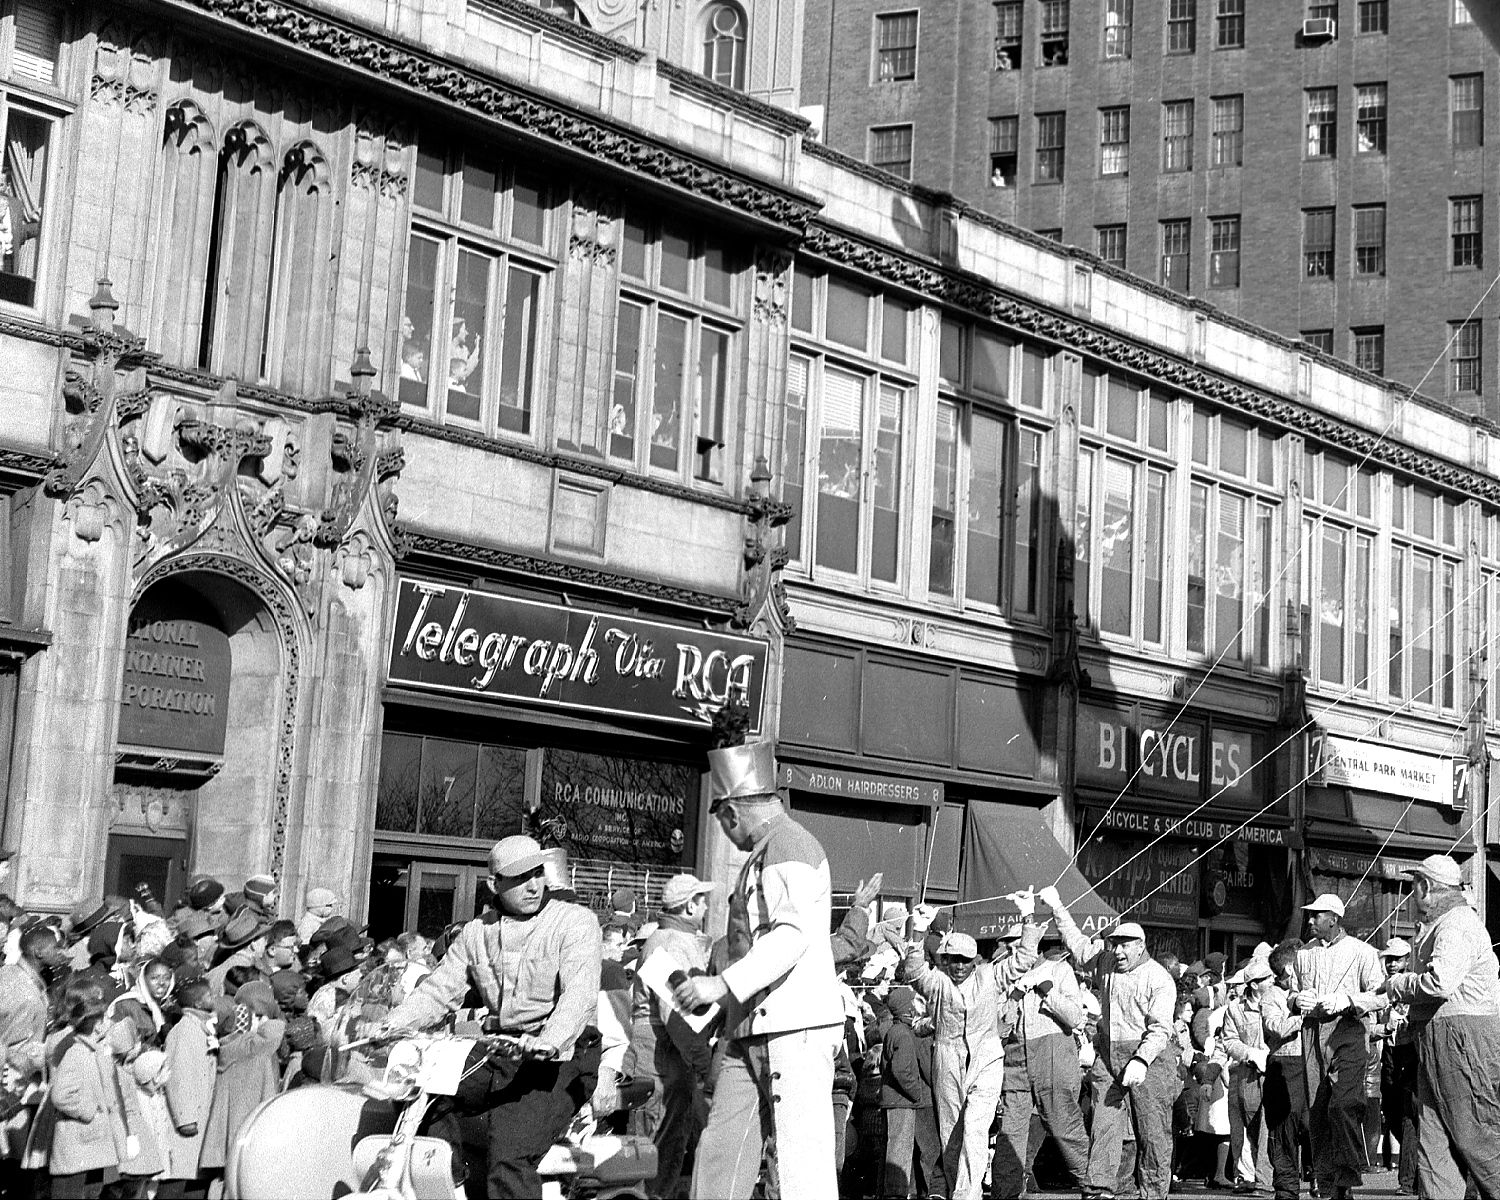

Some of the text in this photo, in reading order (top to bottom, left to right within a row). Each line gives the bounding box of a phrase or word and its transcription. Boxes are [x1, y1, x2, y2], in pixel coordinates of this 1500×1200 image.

[127, 618, 200, 649] TIONAL
[400, 582, 755, 708] Telegraph Via RCA
[125, 650, 205, 682] NTAINER
[121, 684, 216, 717] PORATION
[785, 768, 940, 801] 8 ADLON HAIRDRESSERS 8
[1327, 753, 1370, 772] CENTRAL
[1373, 762, 1396, 777] PARK
[1400, 768, 1436, 785] MARKET
[443, 776, 456, 802] 7
[554, 781, 684, 815] RCA COMMUNICATIONS
[1105, 809, 1284, 845] BICYCLE & SKI CLUB OF AMERICA
[1159, 870, 1194, 895] RENTED
[1223, 869, 1254, 888] PAIRED
